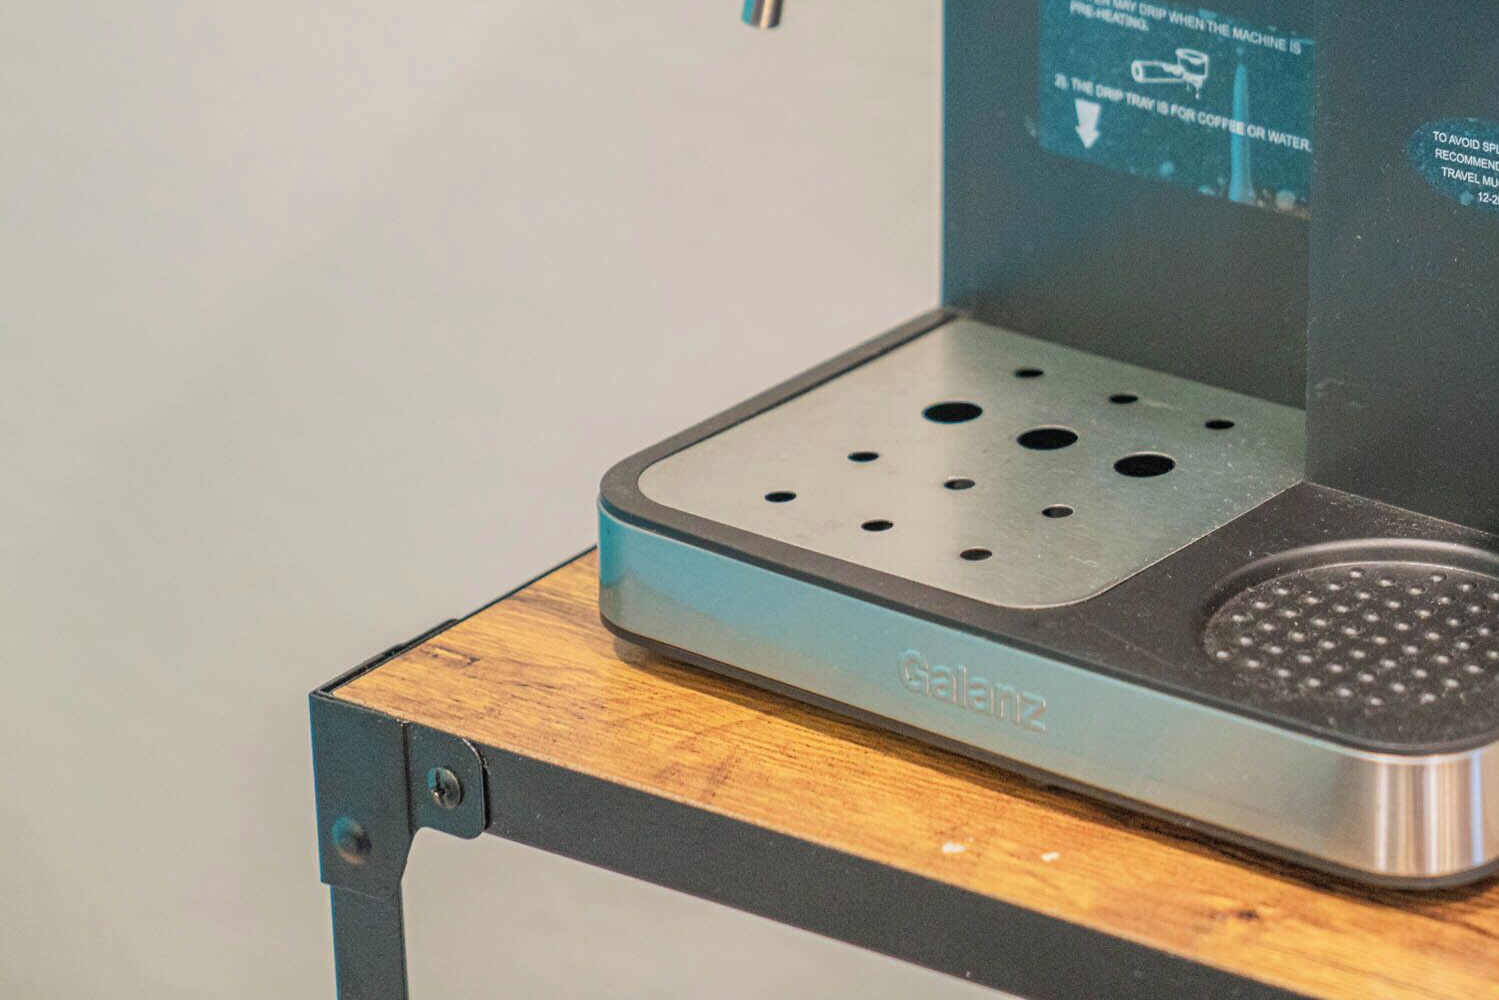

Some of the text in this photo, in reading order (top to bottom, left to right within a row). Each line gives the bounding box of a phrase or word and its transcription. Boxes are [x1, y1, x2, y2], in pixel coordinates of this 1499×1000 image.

[1070, 0, 1150, 32] PRE-HEATING.
[1138, 3, 1167, 20] DRIP
[1168, 10, 1205, 32] WHEN
[1206, 19, 1231, 38] THE
[1232, 26, 1288, 52] MACHINE
[1289, 39, 1302, 56] IS
[1071, 77, 1093, 97] THE
[1095, 84, 1124, 102] DRIP
[1126, 92, 1155, 111] TRAY
[1156, 101, 1169, 115] IS
[1170, 104, 1196, 122] FOR
[1197, 111, 1245, 136] COFFEE
[1246, 124, 1266, 141] OR
[1267, 128, 1313, 153] WATER.
[1432, 130, 1448, 144] TO
[1449, 134, 1481, 151] AVOID
[1441, 166, 1481, 185] TRAVEL
[898, 648, 1047, 733] Galanz
